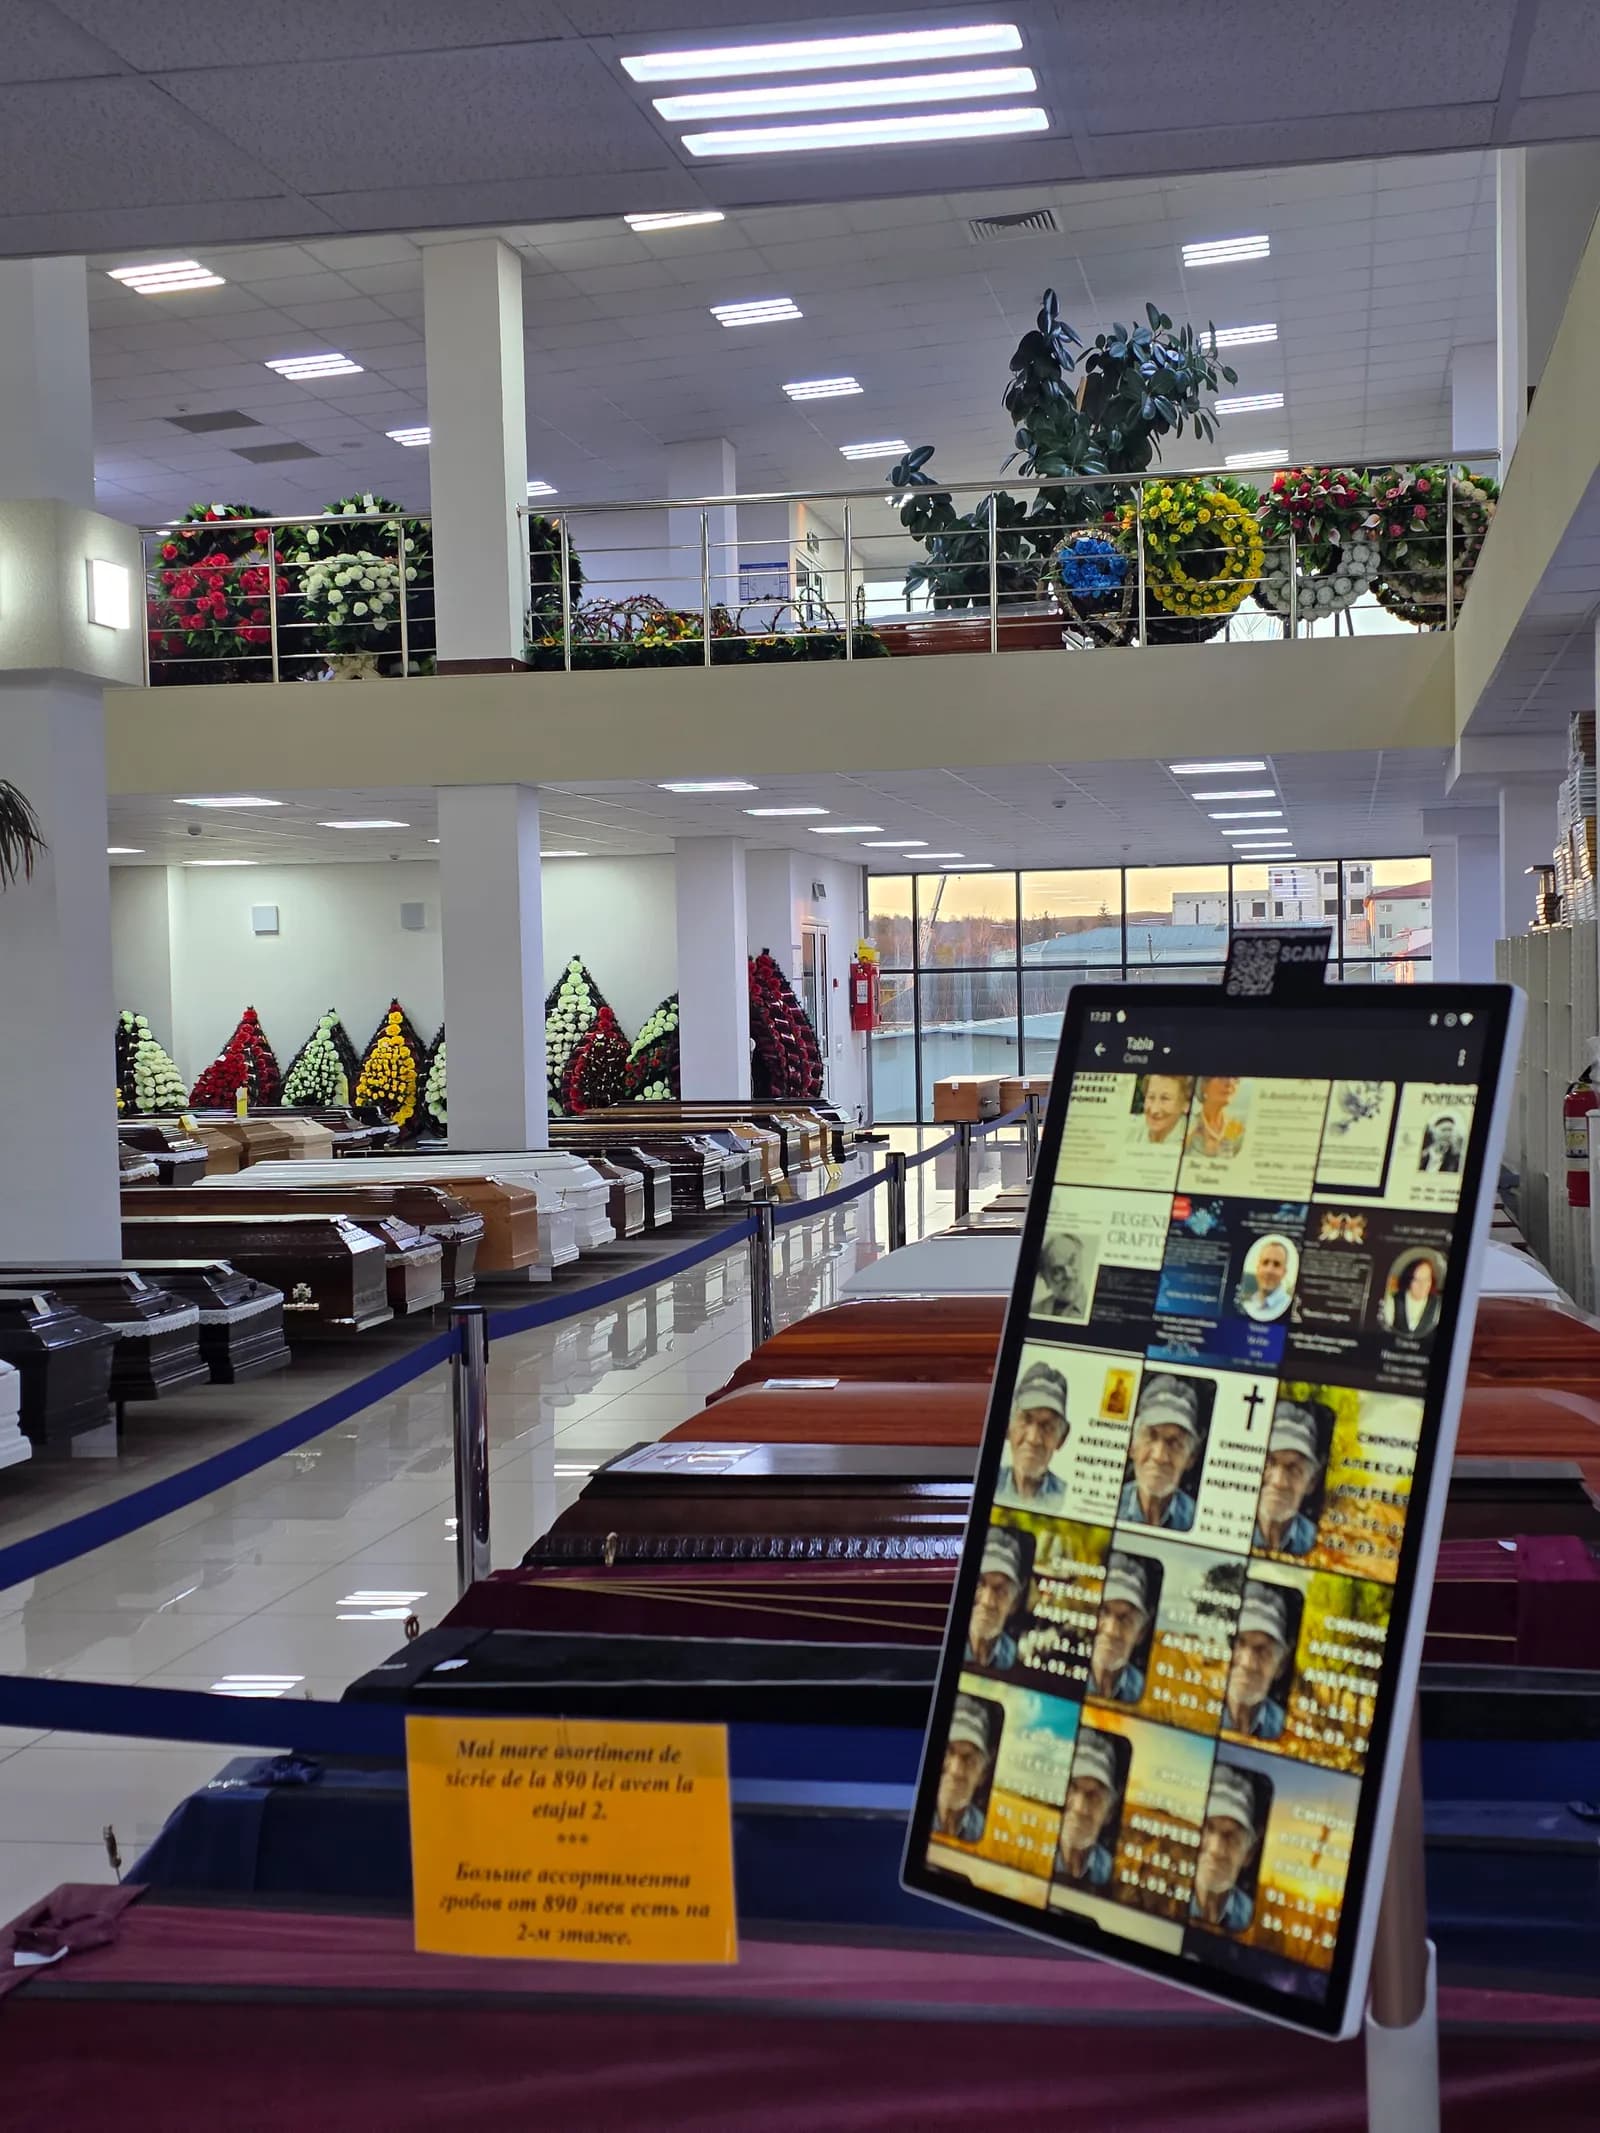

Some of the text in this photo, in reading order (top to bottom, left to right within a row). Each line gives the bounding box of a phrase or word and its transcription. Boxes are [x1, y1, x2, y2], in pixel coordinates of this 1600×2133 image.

[1279, 944, 1328, 962] SCAN
[456, 1740, 681, 1765] Mai mare asortiment de
[445, 1769, 694, 1794] sicrie de la 890 lei avem la
[532, 1802, 608, 1823] etajul 2.
[455, 1862, 691, 1889] Больше ассортимента
[440, 1892, 710, 1919] гробов от 890 леев есть на
[516, 1922, 632, 1946] 2-м этаже.
